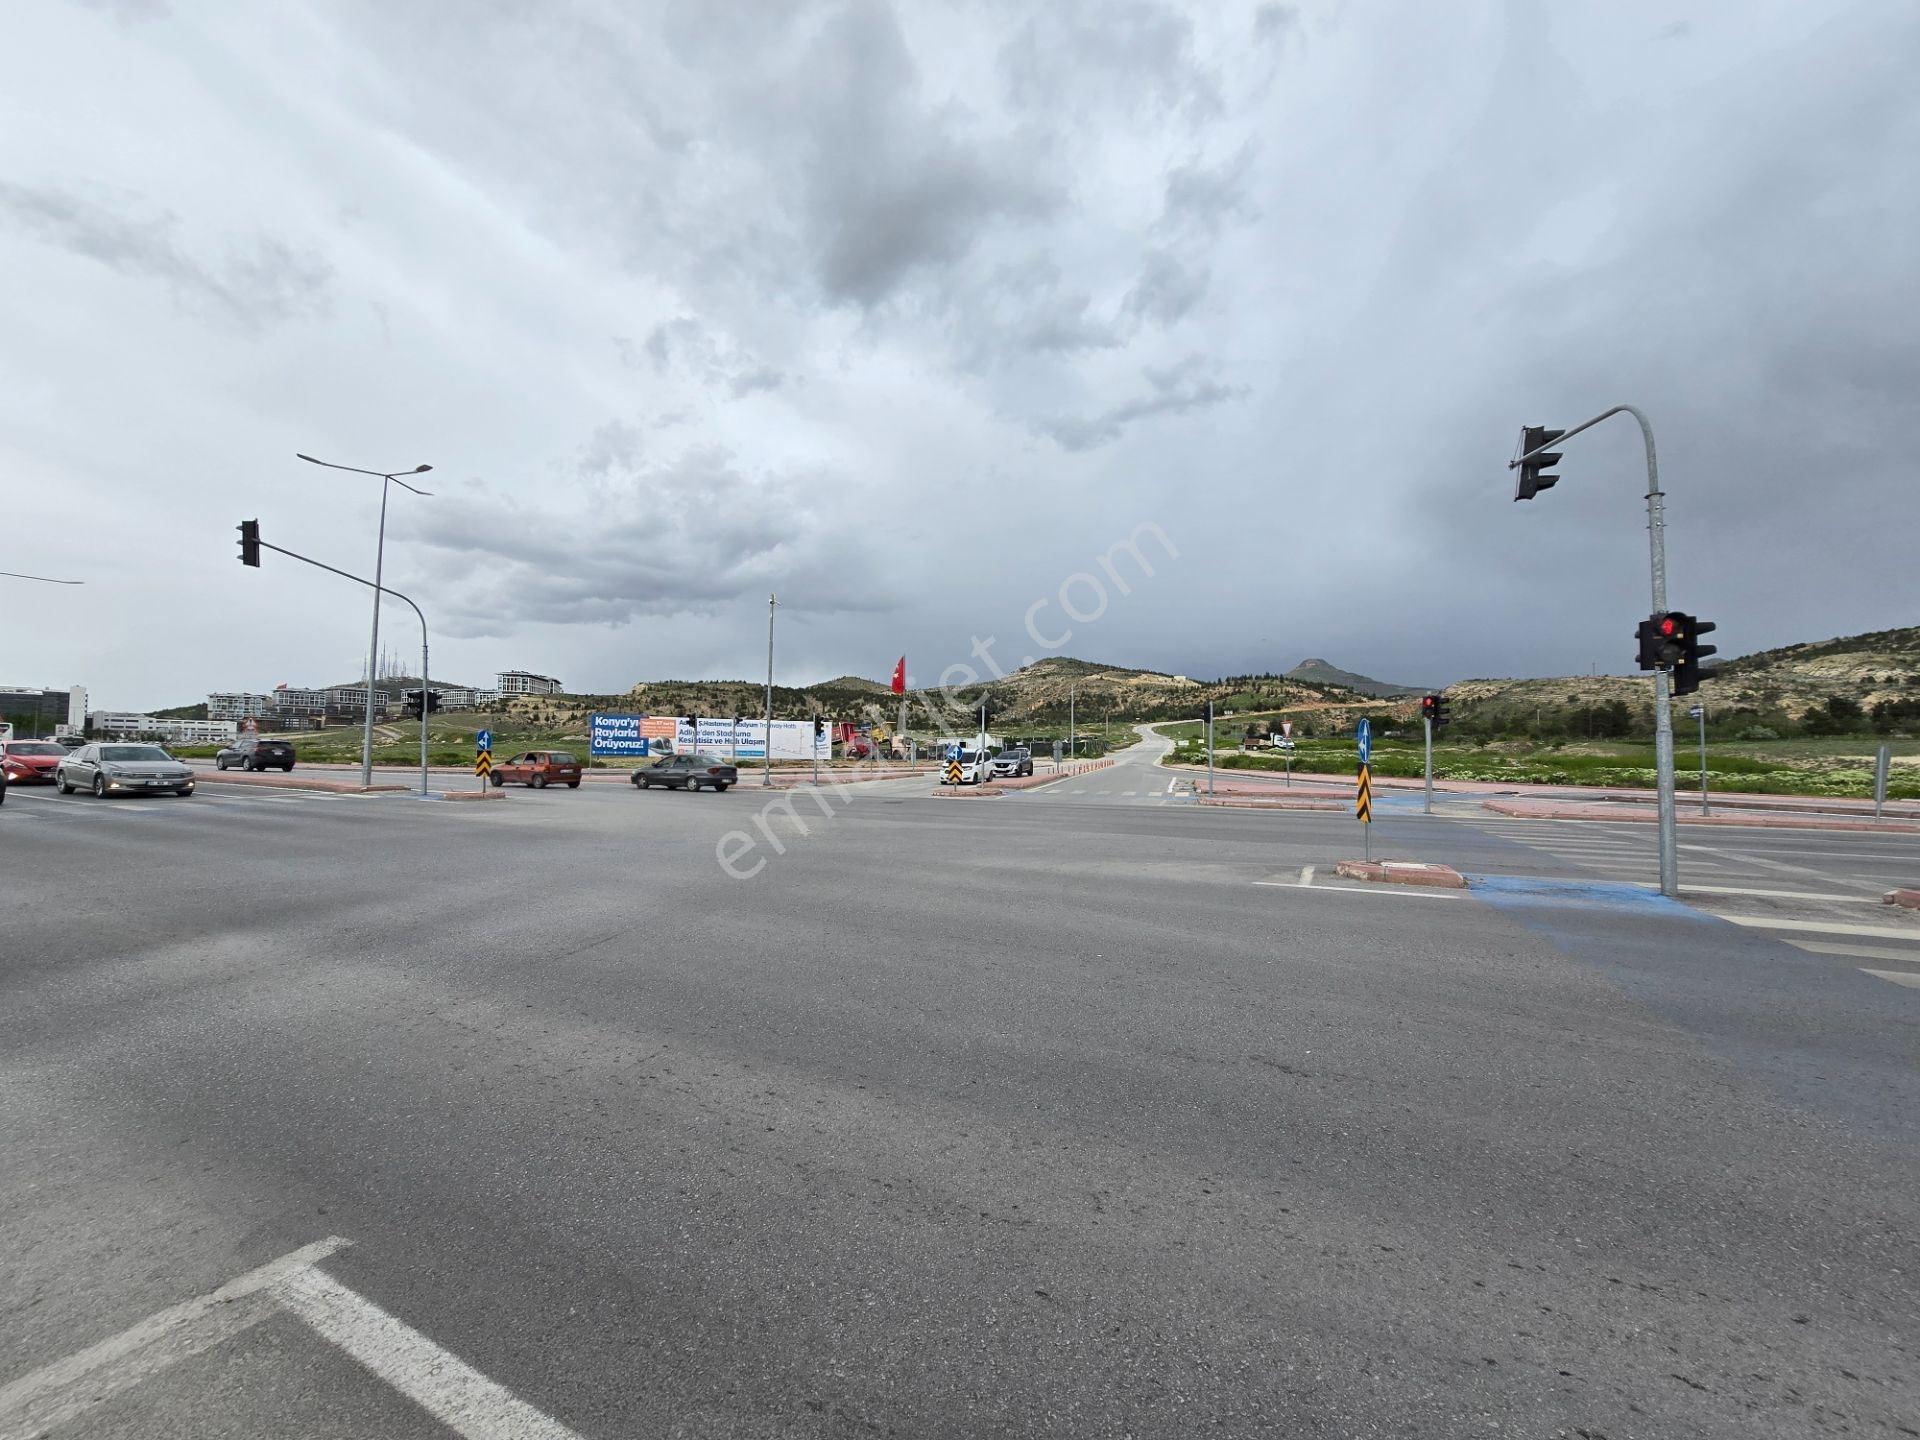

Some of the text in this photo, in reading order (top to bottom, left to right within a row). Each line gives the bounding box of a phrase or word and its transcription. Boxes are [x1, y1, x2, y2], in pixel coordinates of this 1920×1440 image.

[595, 716, 640, 728] Konya'yı
[594, 727, 638, 738] Raylarla
[594, 737, 644, 749] Örüyoruz!
[741, 738, 766, 746] Ulaşım
